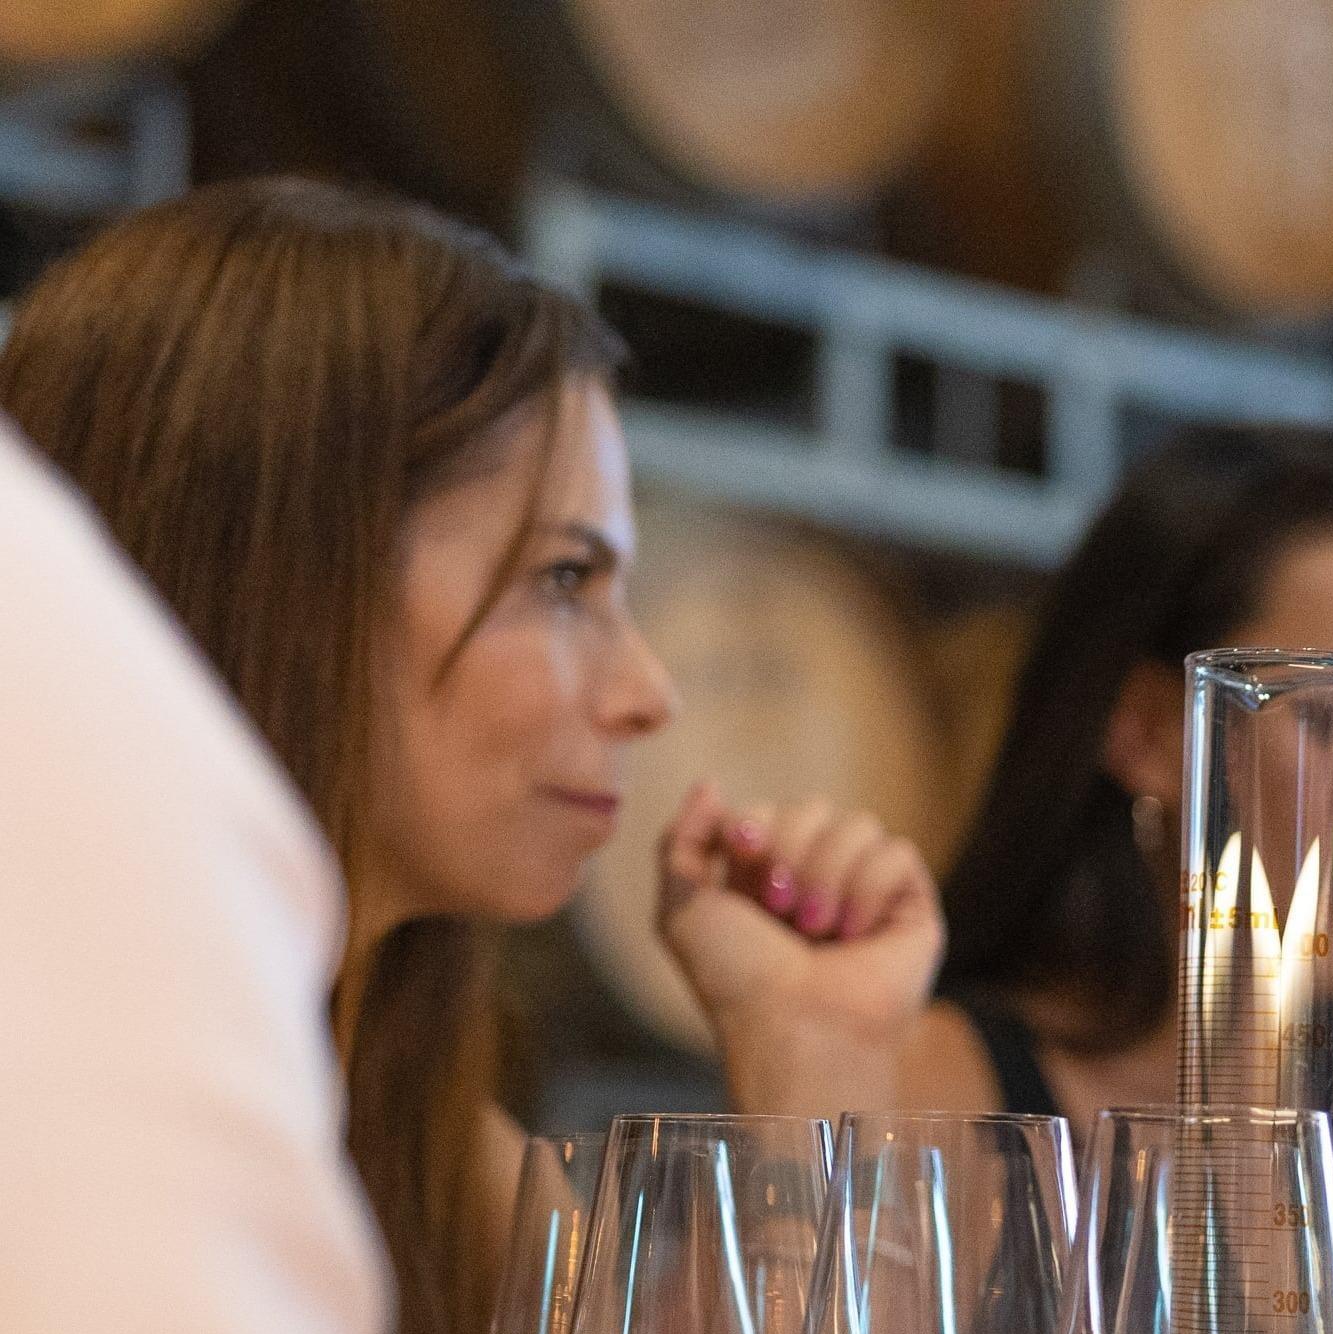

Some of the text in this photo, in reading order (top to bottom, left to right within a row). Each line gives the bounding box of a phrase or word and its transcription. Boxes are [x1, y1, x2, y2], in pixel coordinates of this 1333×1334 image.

[1283, 1022, 1329, 1048] 450
[1273, 1202, 1310, 1228] 350
[1272, 1290, 1311, 1314] 300
